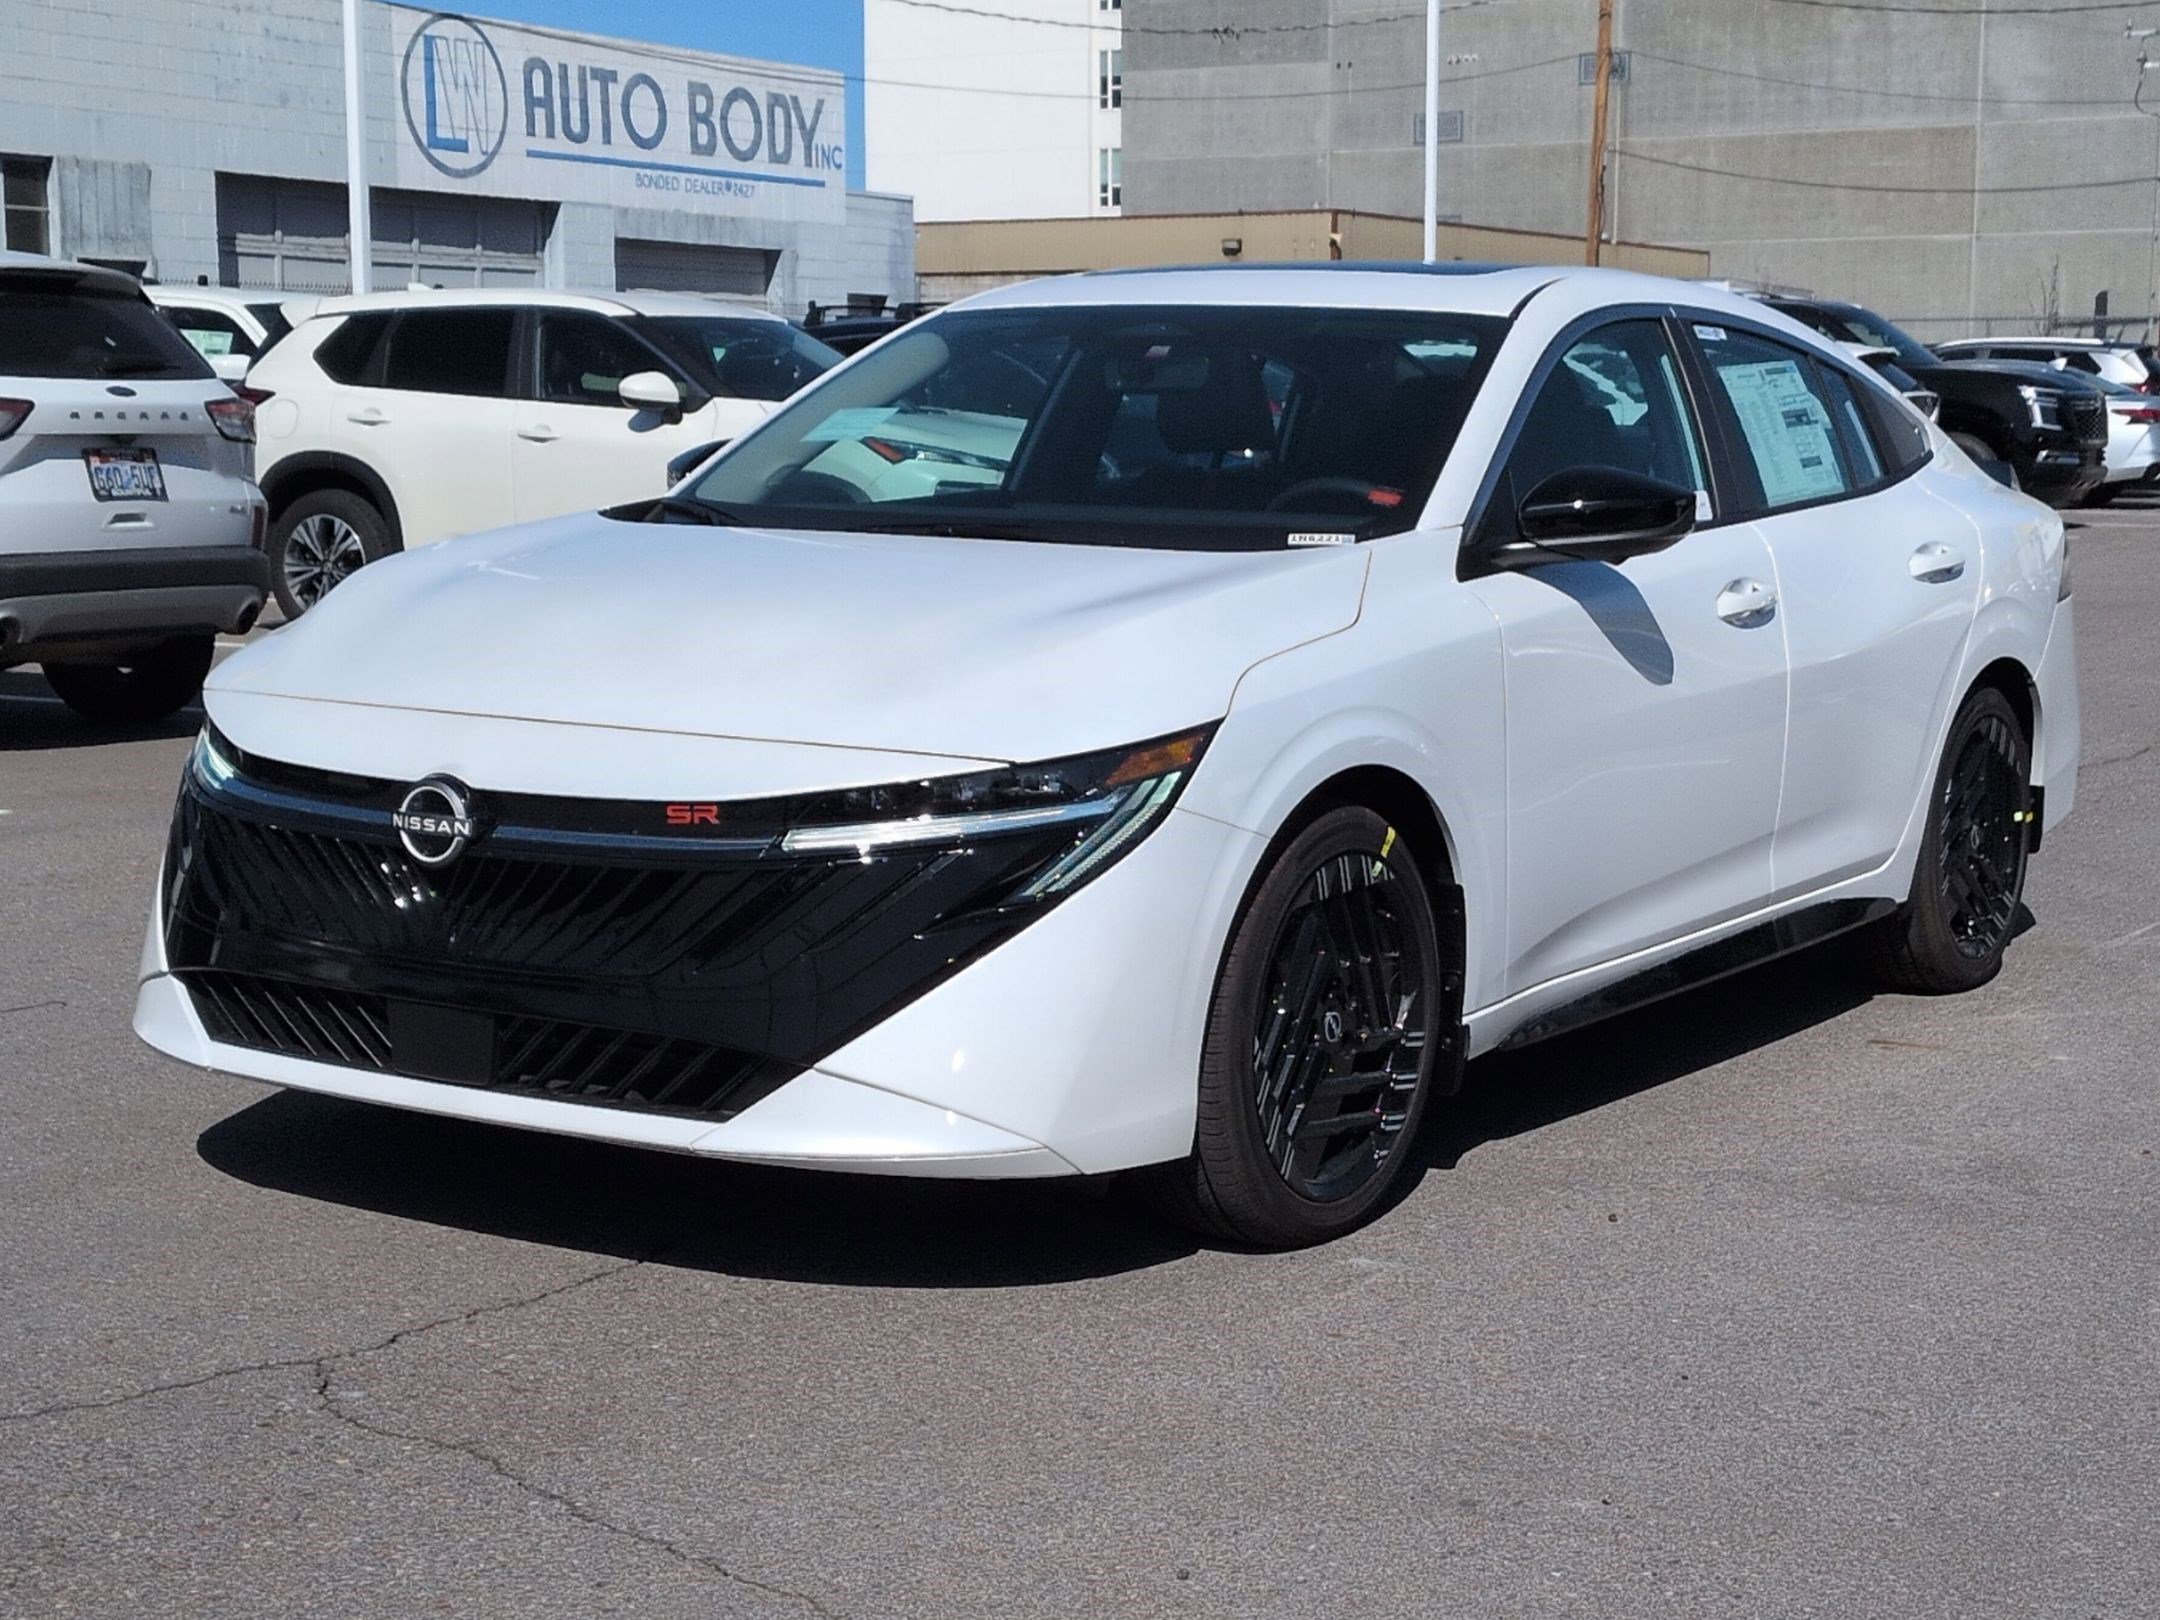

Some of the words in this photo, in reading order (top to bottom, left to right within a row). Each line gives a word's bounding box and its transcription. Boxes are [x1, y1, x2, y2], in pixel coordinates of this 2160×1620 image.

[522, 56, 668, 150] AUTO
[687, 80, 825, 168] BODY
[813, 143, 844, 170] INC
[635, 172, 680, 192] BONDED
[392, 813, 472, 836] NISSAN
[666, 804, 720, 825] SR
